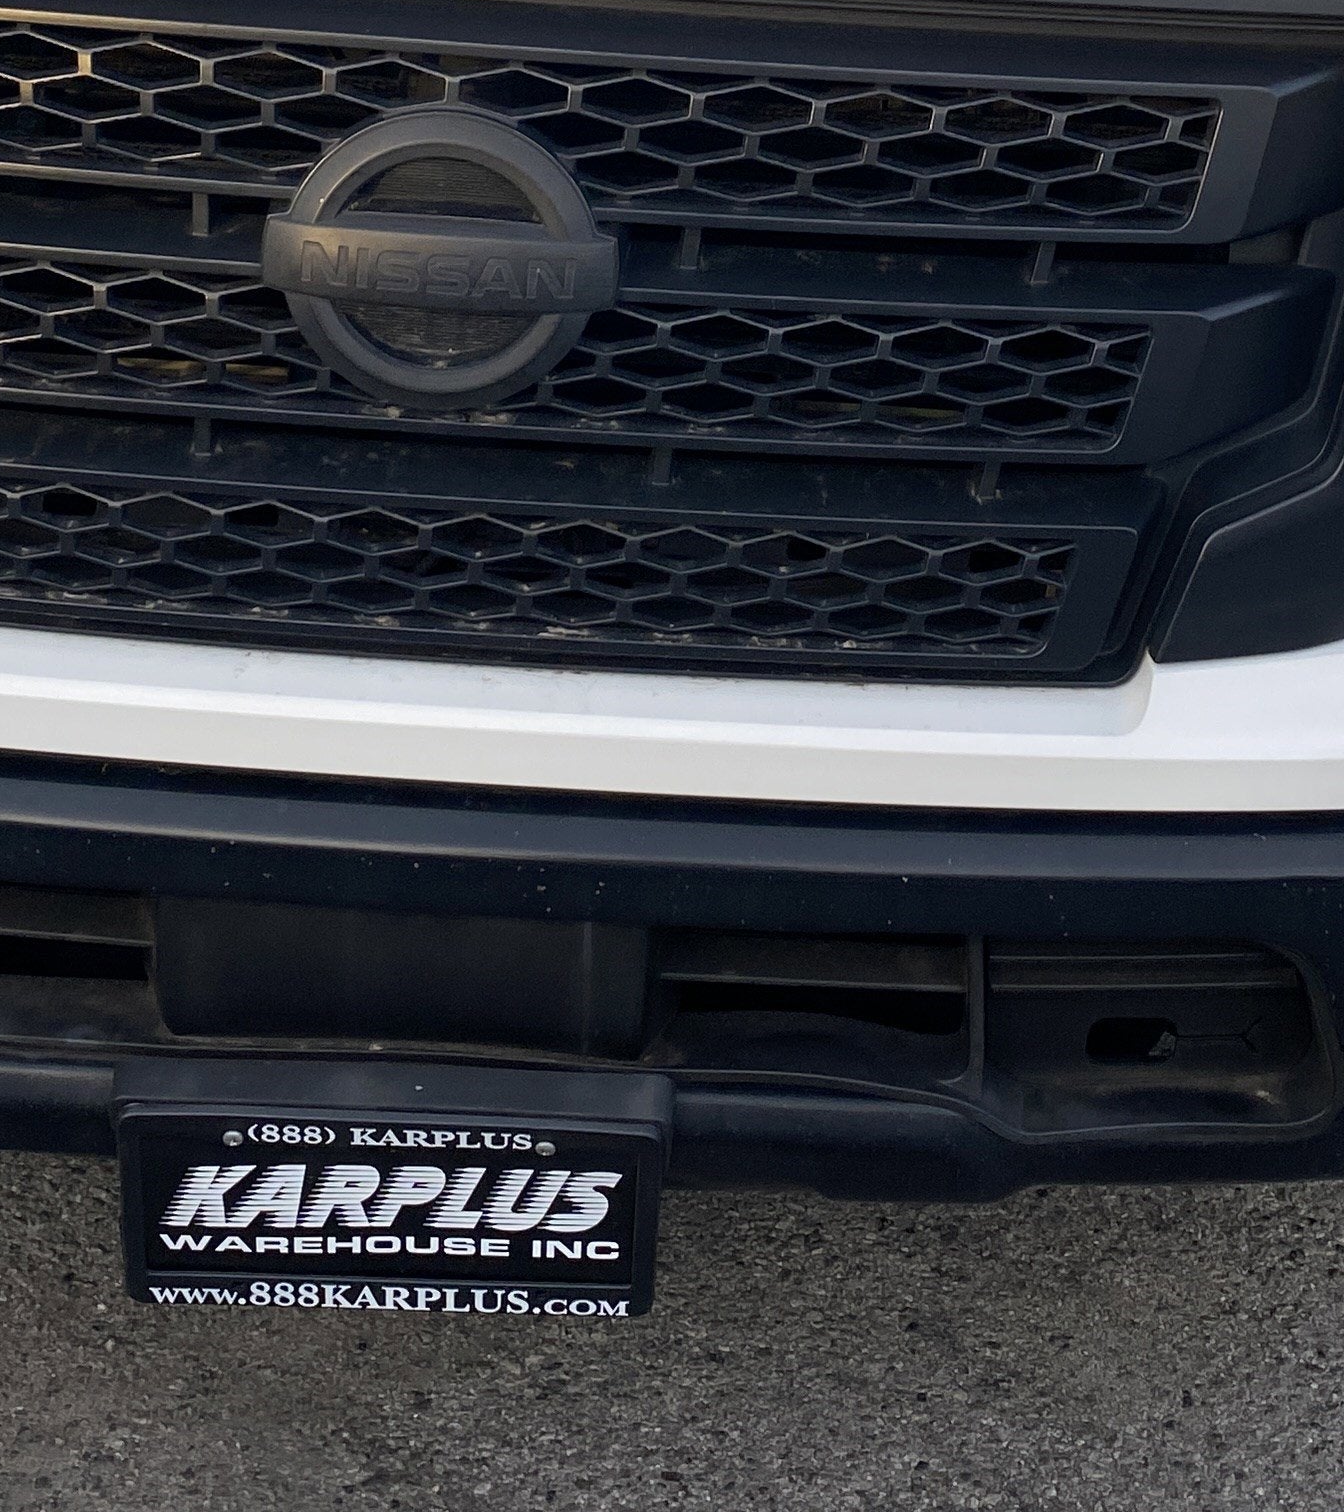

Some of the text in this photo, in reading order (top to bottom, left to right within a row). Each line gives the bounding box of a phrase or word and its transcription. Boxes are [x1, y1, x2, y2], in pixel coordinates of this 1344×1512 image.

[300, 240, 578, 301] NISSAN
[246, 1123, 533, 1151] (888) KARPLUS
[157, 1163, 624, 1233] KARPLUS
[158, 1233, 620, 1260] WAREHOUSE INC
